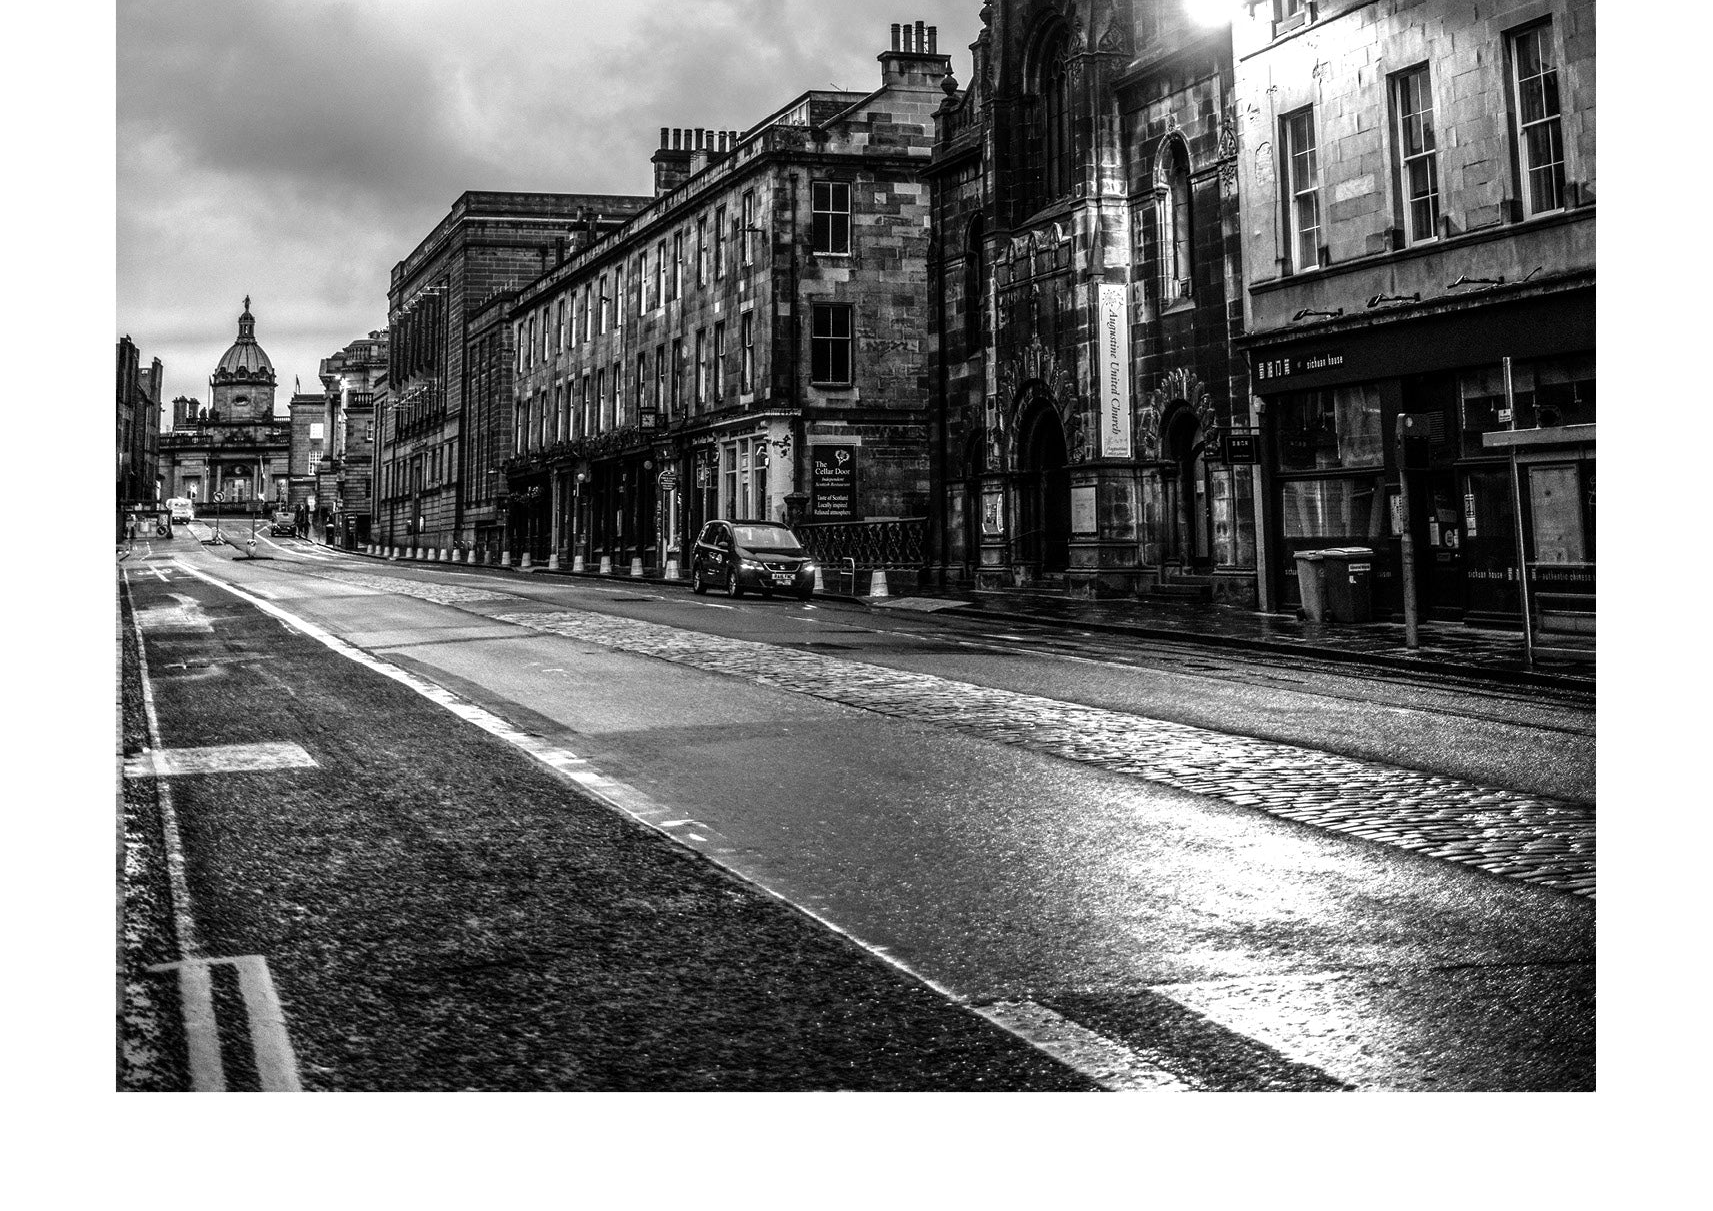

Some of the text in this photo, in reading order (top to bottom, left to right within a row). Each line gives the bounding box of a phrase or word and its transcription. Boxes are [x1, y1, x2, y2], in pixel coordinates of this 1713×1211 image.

[1107, 309, 1122, 435] Augustine United Church
[1306, 356, 1326, 370] sichuan
[1327, 353, 1343, 365] house
